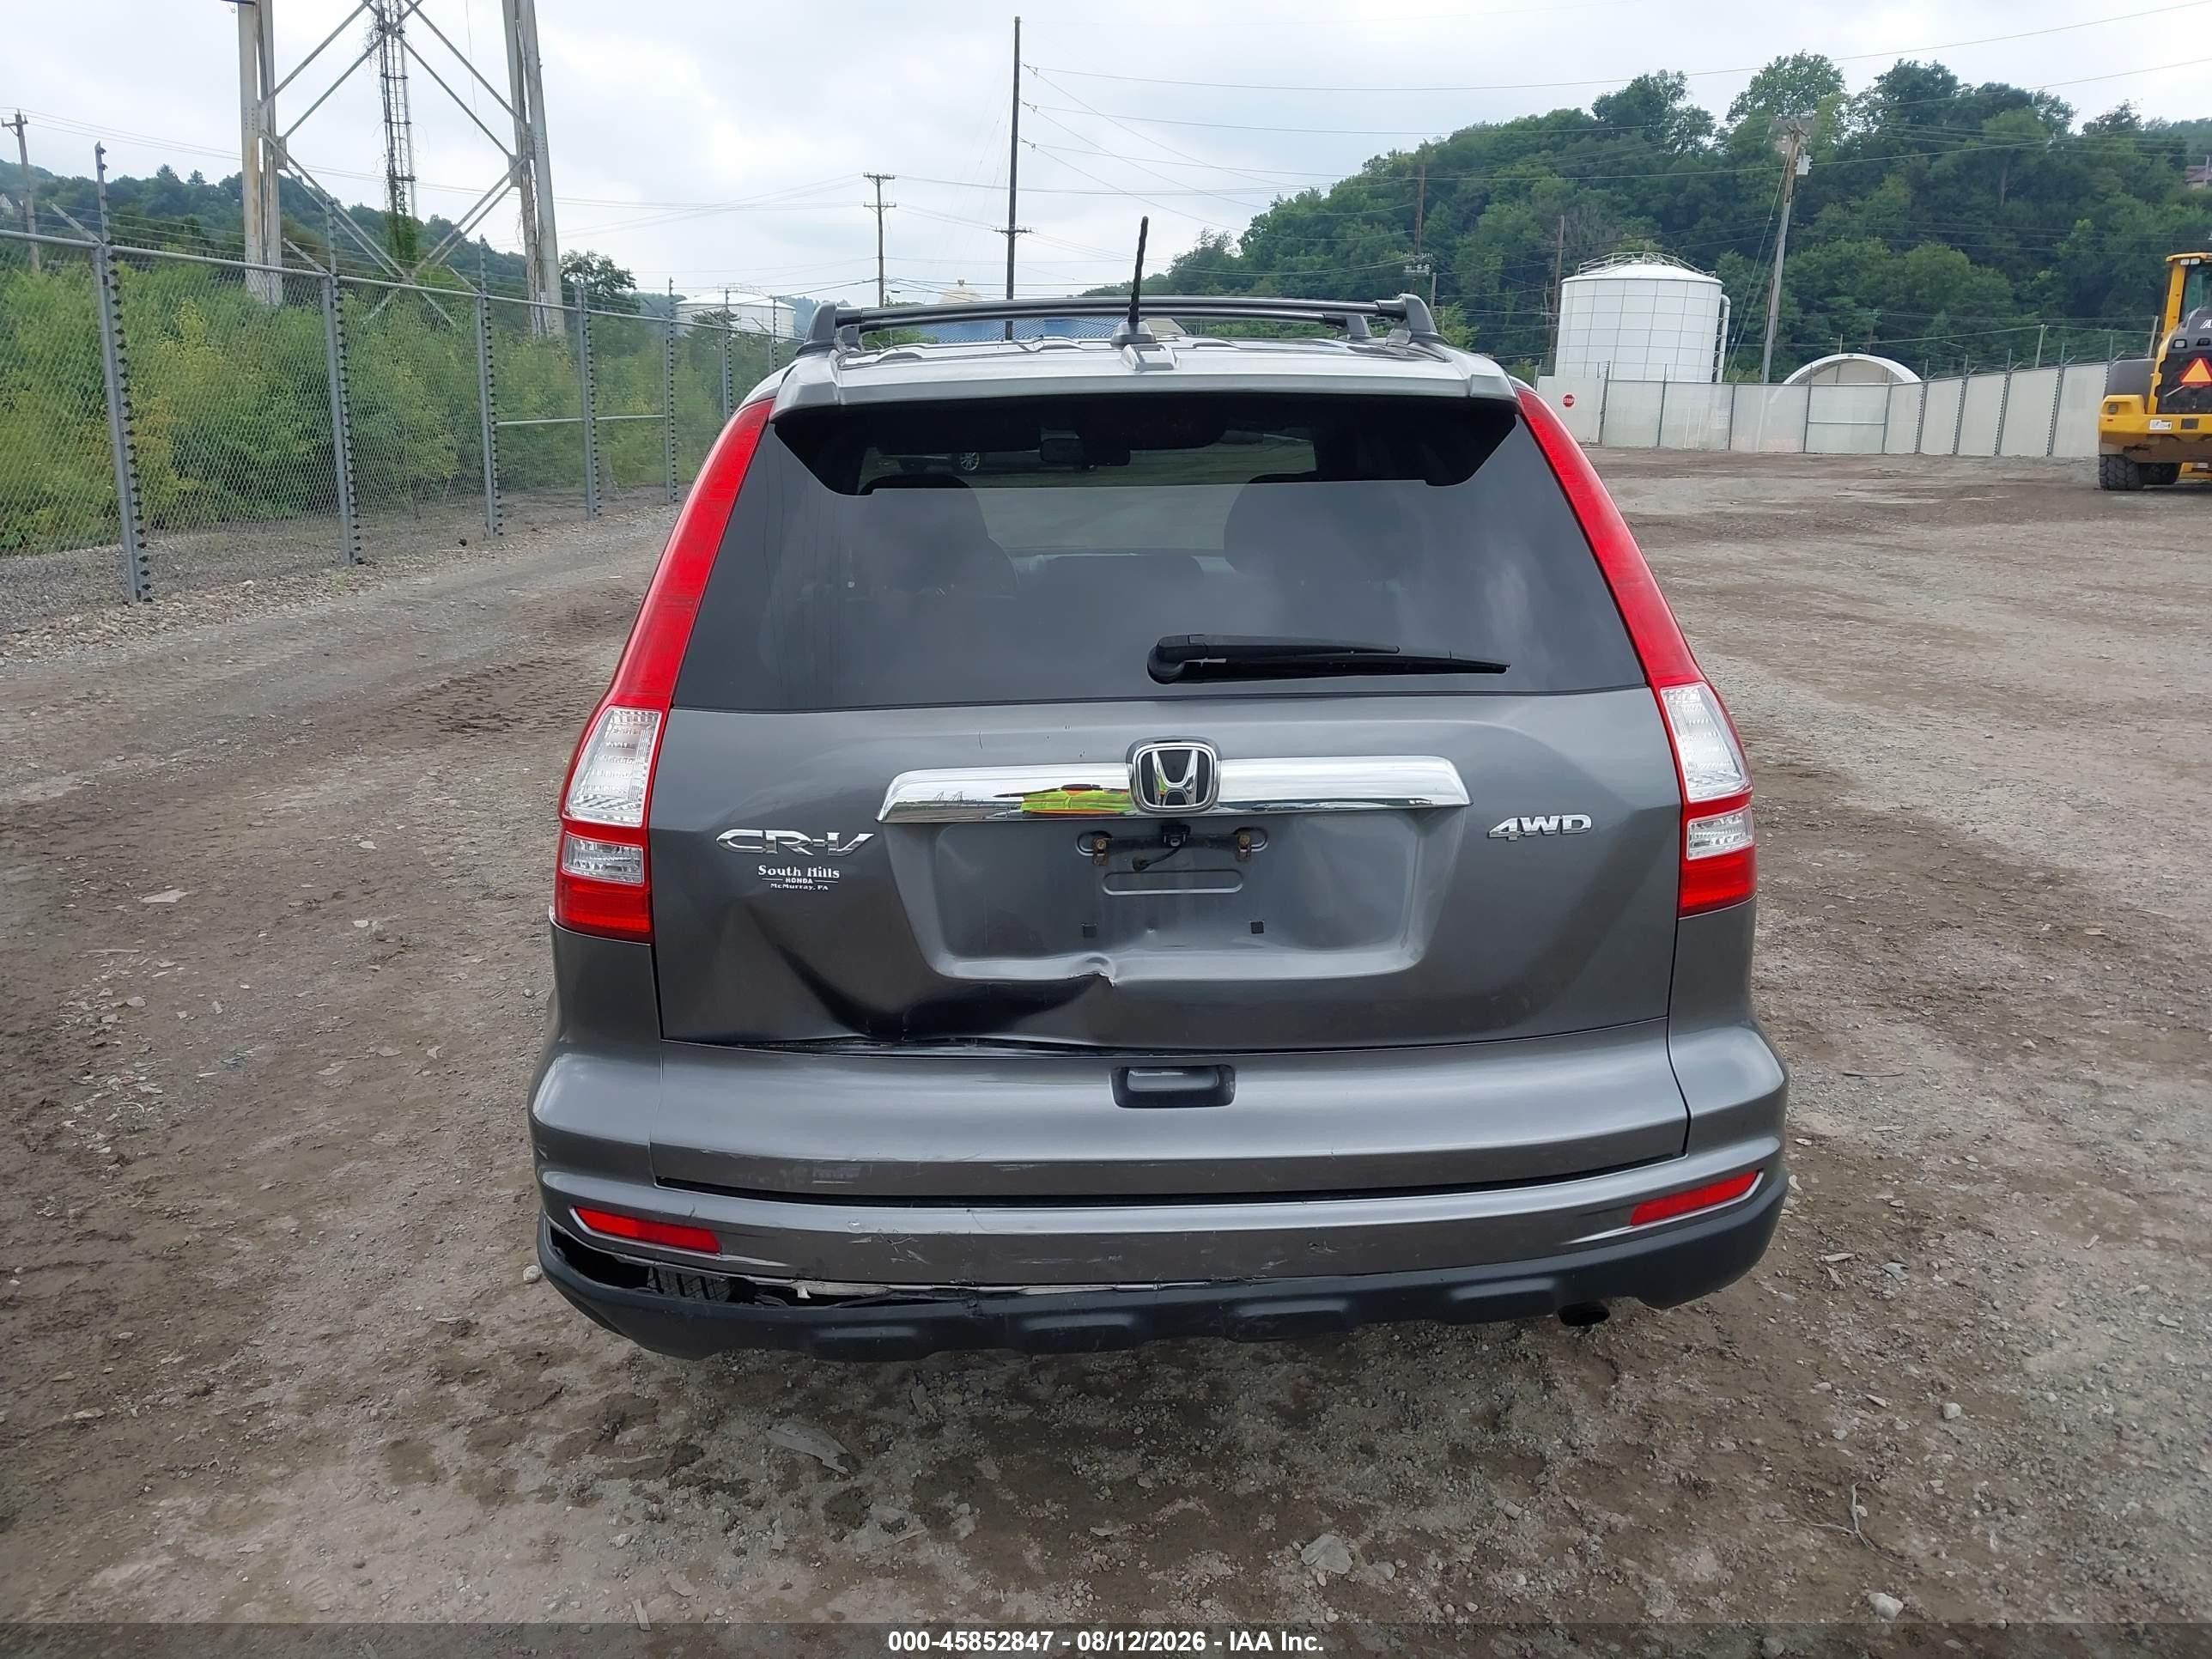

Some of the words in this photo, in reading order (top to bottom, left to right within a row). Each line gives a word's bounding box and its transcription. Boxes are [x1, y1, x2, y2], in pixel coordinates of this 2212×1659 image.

[1488, 814, 1592, 842] 4WD
[716, 829, 875, 856] CR-V
[757, 865, 802, 878] South
[806, 866, 841, 878] Hills
[769, 883, 816, 891] McMurray,
